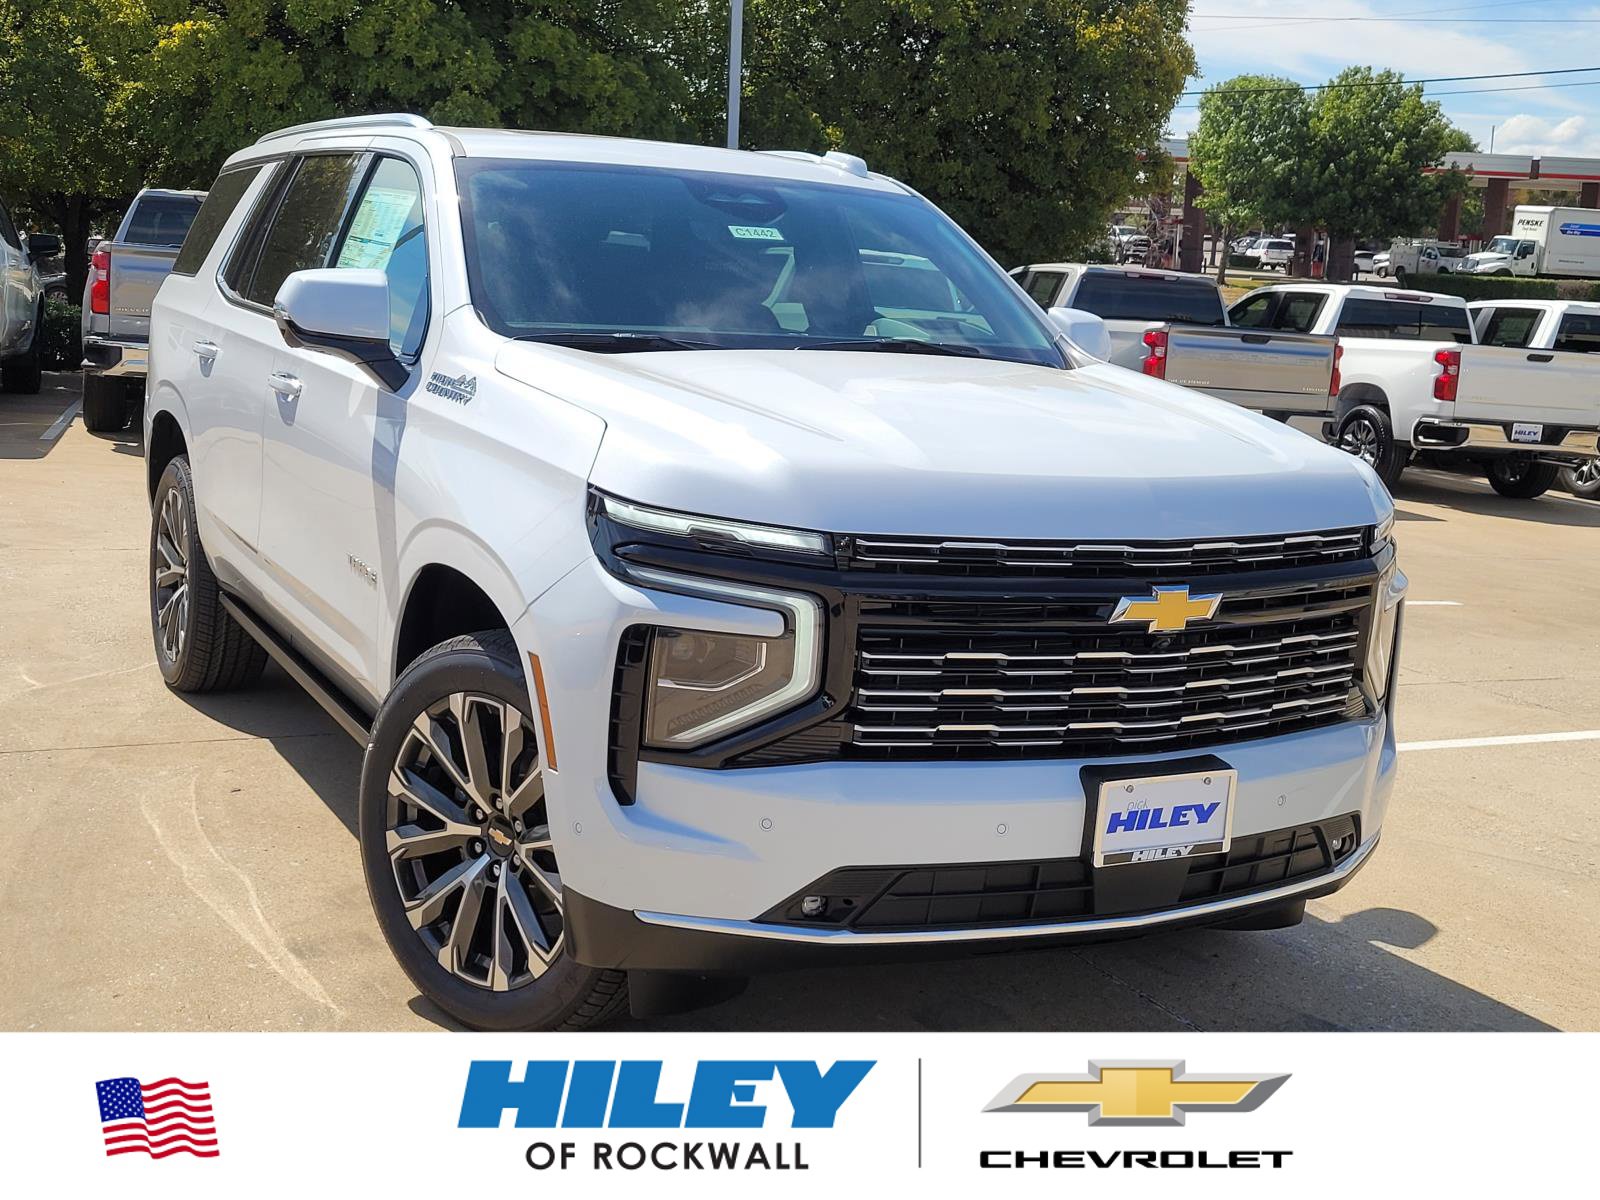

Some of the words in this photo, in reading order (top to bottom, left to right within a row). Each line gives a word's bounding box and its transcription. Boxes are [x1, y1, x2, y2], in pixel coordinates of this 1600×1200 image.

[1518, 219, 1544, 227] PENSKE
[735, 228, 777, 238] C1442
[1106, 802, 1221, 834] HILEY
[1131, 845, 1194, 862] HILEY
